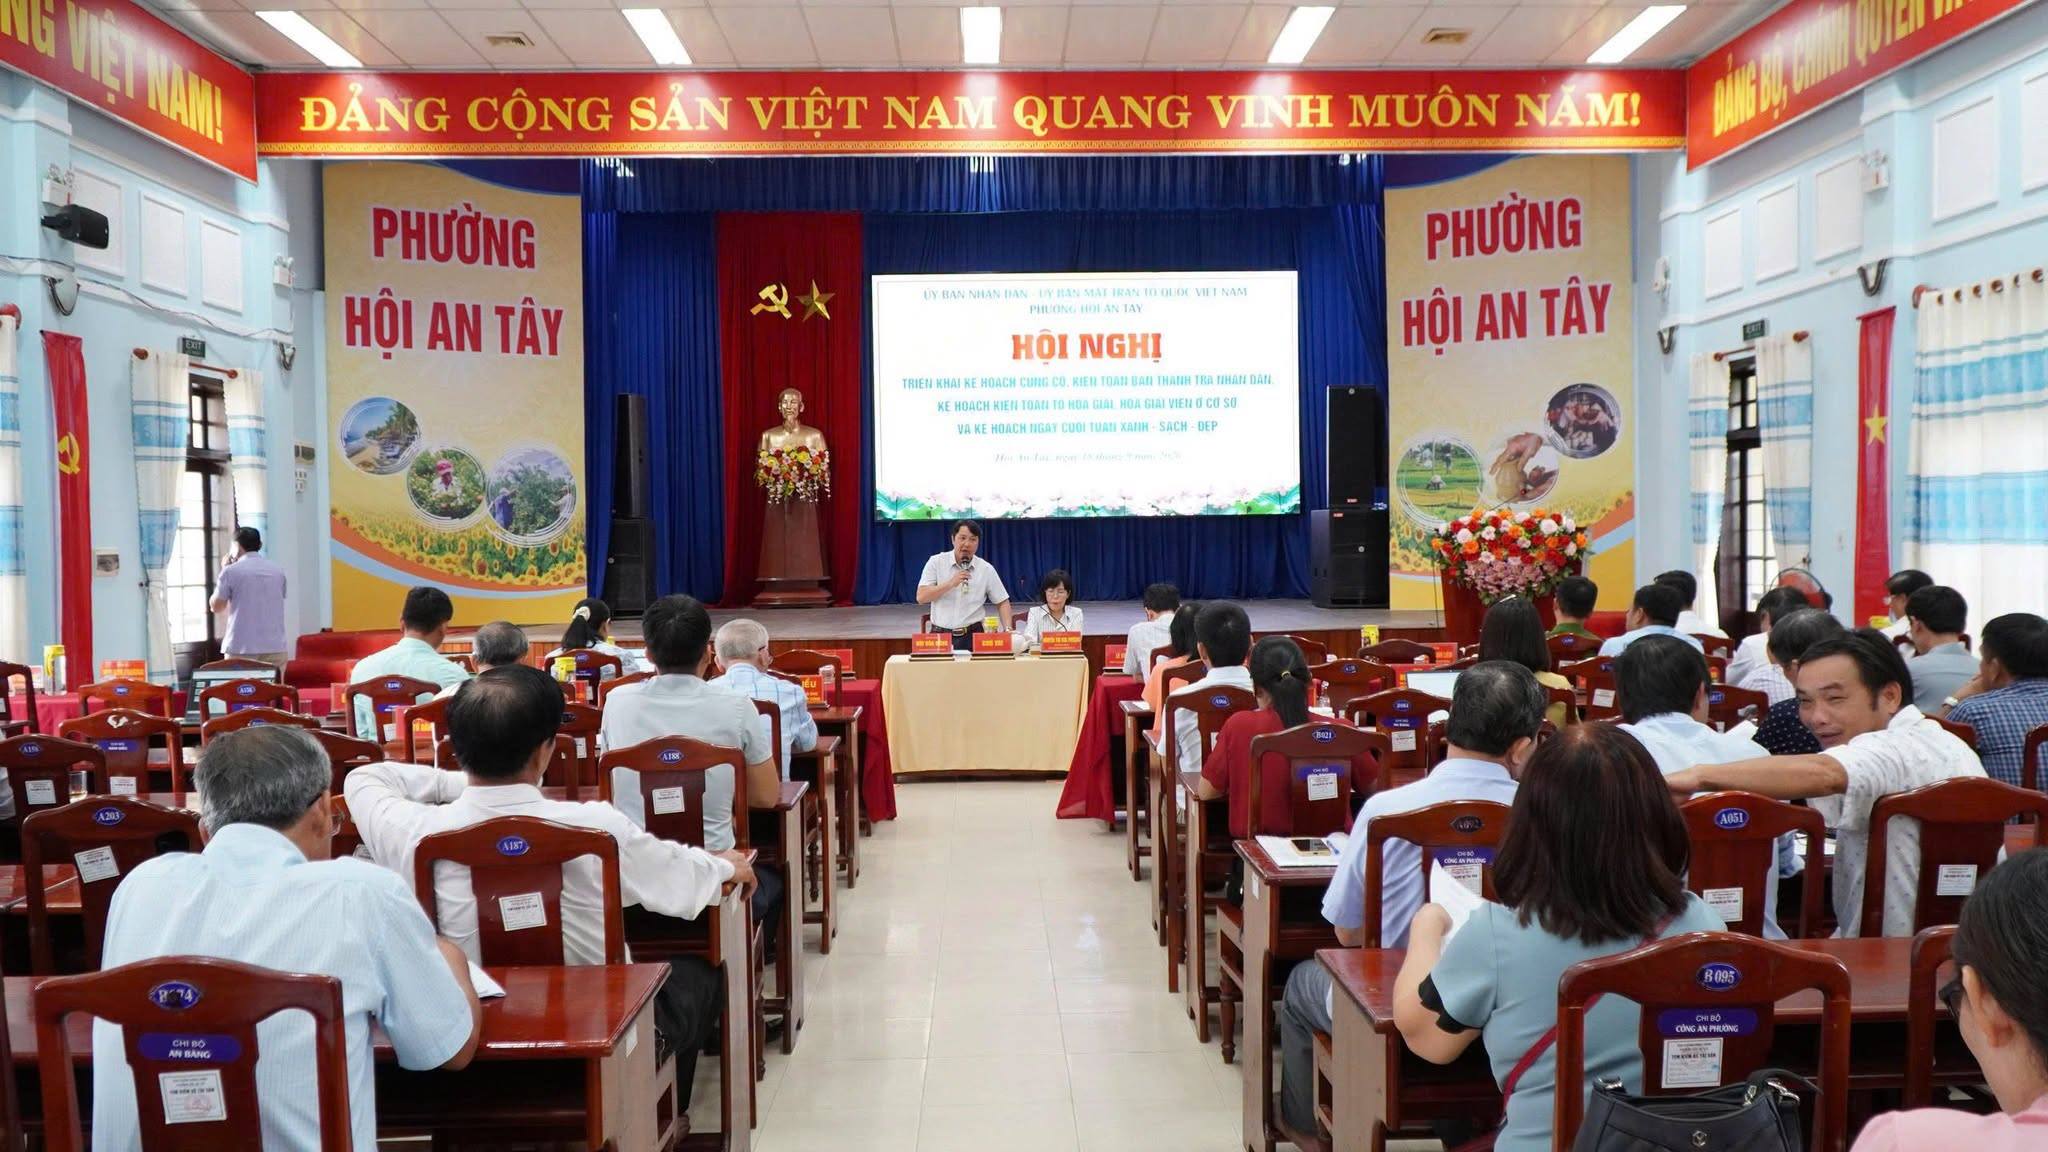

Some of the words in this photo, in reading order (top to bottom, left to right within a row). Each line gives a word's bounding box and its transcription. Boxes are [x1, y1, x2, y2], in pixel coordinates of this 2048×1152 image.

[67, 3, 136, 105] VIỆT
[147, 47, 223, 145] NAM!
[1713, 52, 1756, 138] ĐẢNG
[299, 82, 451, 133] ĐẢNG
[467, 87, 613, 141] CỘNG
[629, 82, 730, 132] SẢN
[747, 87, 869, 139] VIỆT
[883, 95, 997, 130] NAM
[1013, 94, 1193, 137] QUANG
[1212, 95, 1333, 130] VINH
[1347, 85, 1501, 129] MUÔN
[1514, 84, 1643, 128] NĂM!
[1426, 190, 1583, 261] PHƯỜNG
[371, 201, 536, 270] PHƯỜNG
[1402, 293, 1462, 357] HỘI
[1475, 289, 1527, 342] AN
[1540, 275, 1612, 336] TÂY
[344, 287, 412, 360] HỘI
[427, 301, 482, 353] AN
[494, 296, 564, 357] TÂY
[1011, 328, 1069, 365] HỘI
[1078, 332, 1162, 363] NGHỊ
[1316, 731, 1333, 739] B021
[662, 752, 680, 761] A188
[96, 811, 120, 822] A203
[1719, 812, 1744, 825] A051
[502, 840, 523, 851] A187
[159, 988, 194, 1003] B74
[1696, 1014, 1709, 1022] CHI
[1675, 1023, 1696, 1033] CÔNG
[1697, 1024, 1708, 1033] AN
[172, 1039, 189, 1048] CHI
[168, 1049, 182, 1058] AN
